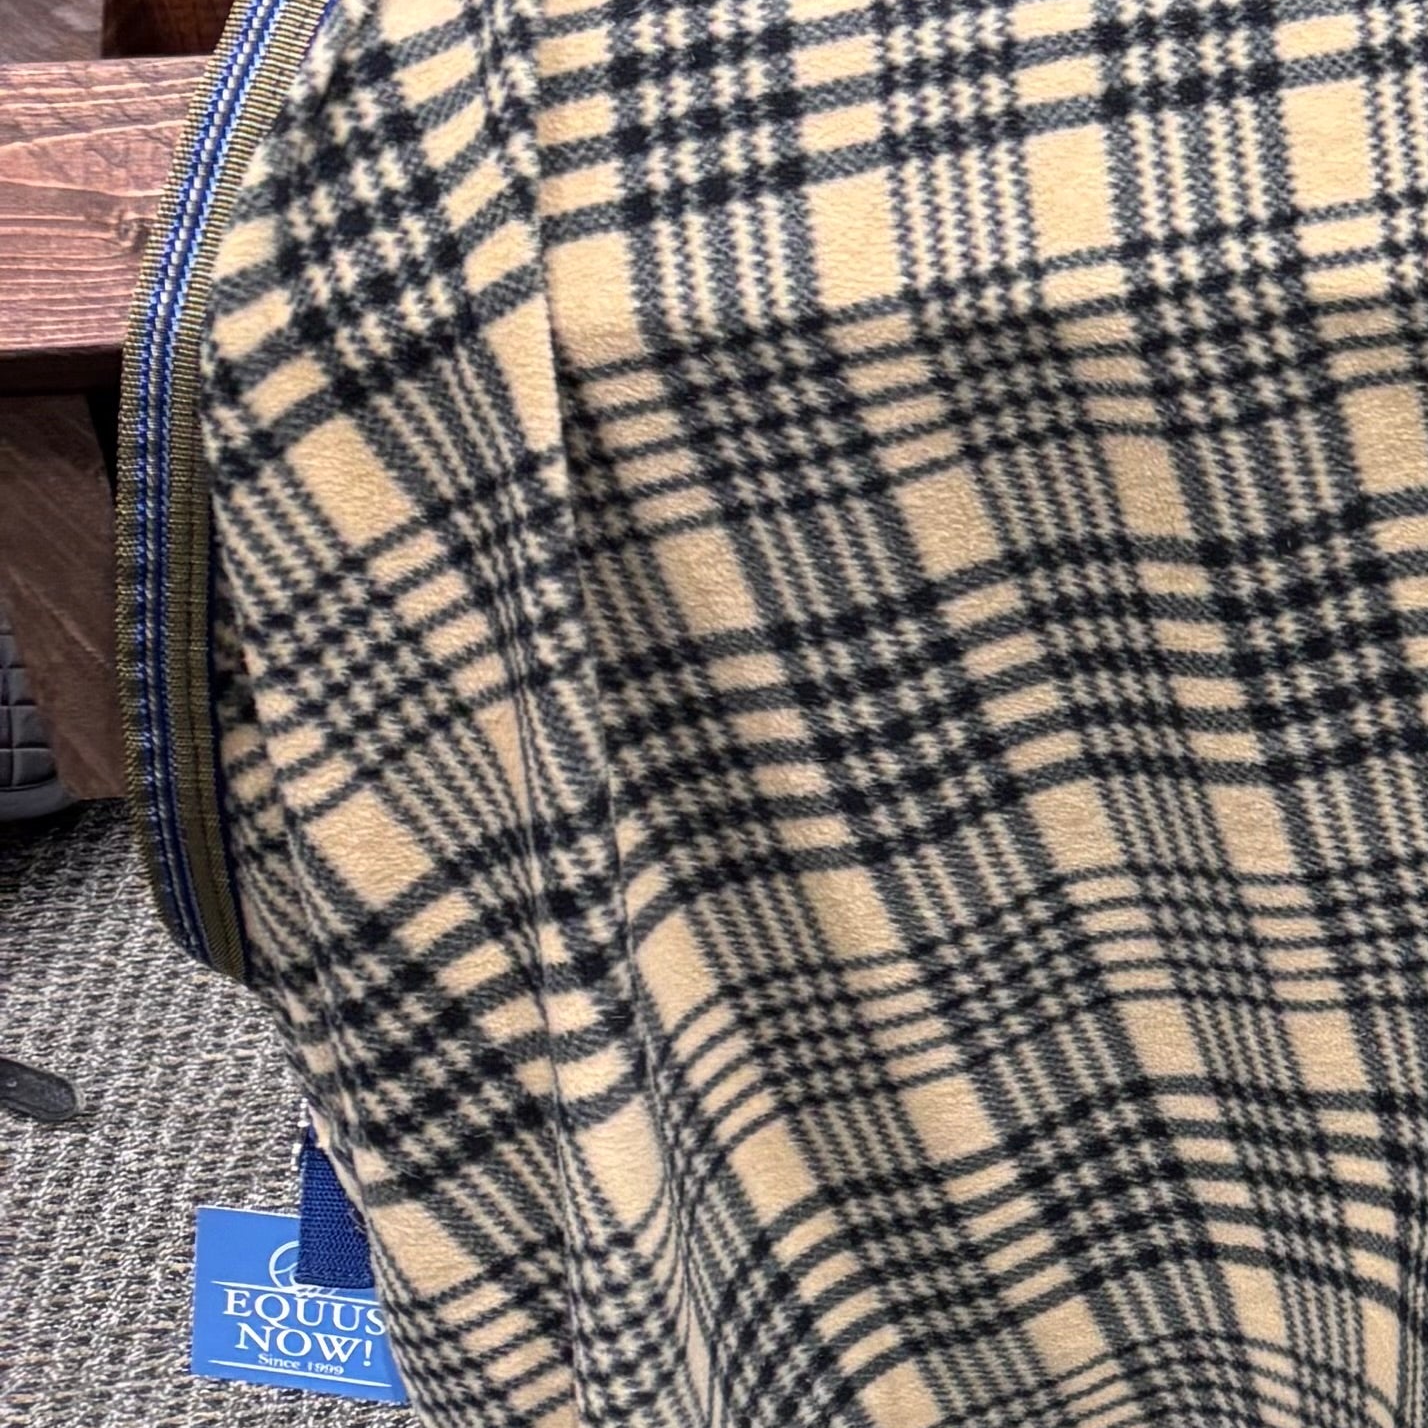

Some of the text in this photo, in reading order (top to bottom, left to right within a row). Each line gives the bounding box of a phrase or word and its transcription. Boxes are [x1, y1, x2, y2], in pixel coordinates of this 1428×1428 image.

[222, 1288, 386, 1336] EQUUS
[234, 1322, 373, 1367] NOW!
[257, 1353, 345, 1376] Since 1999
